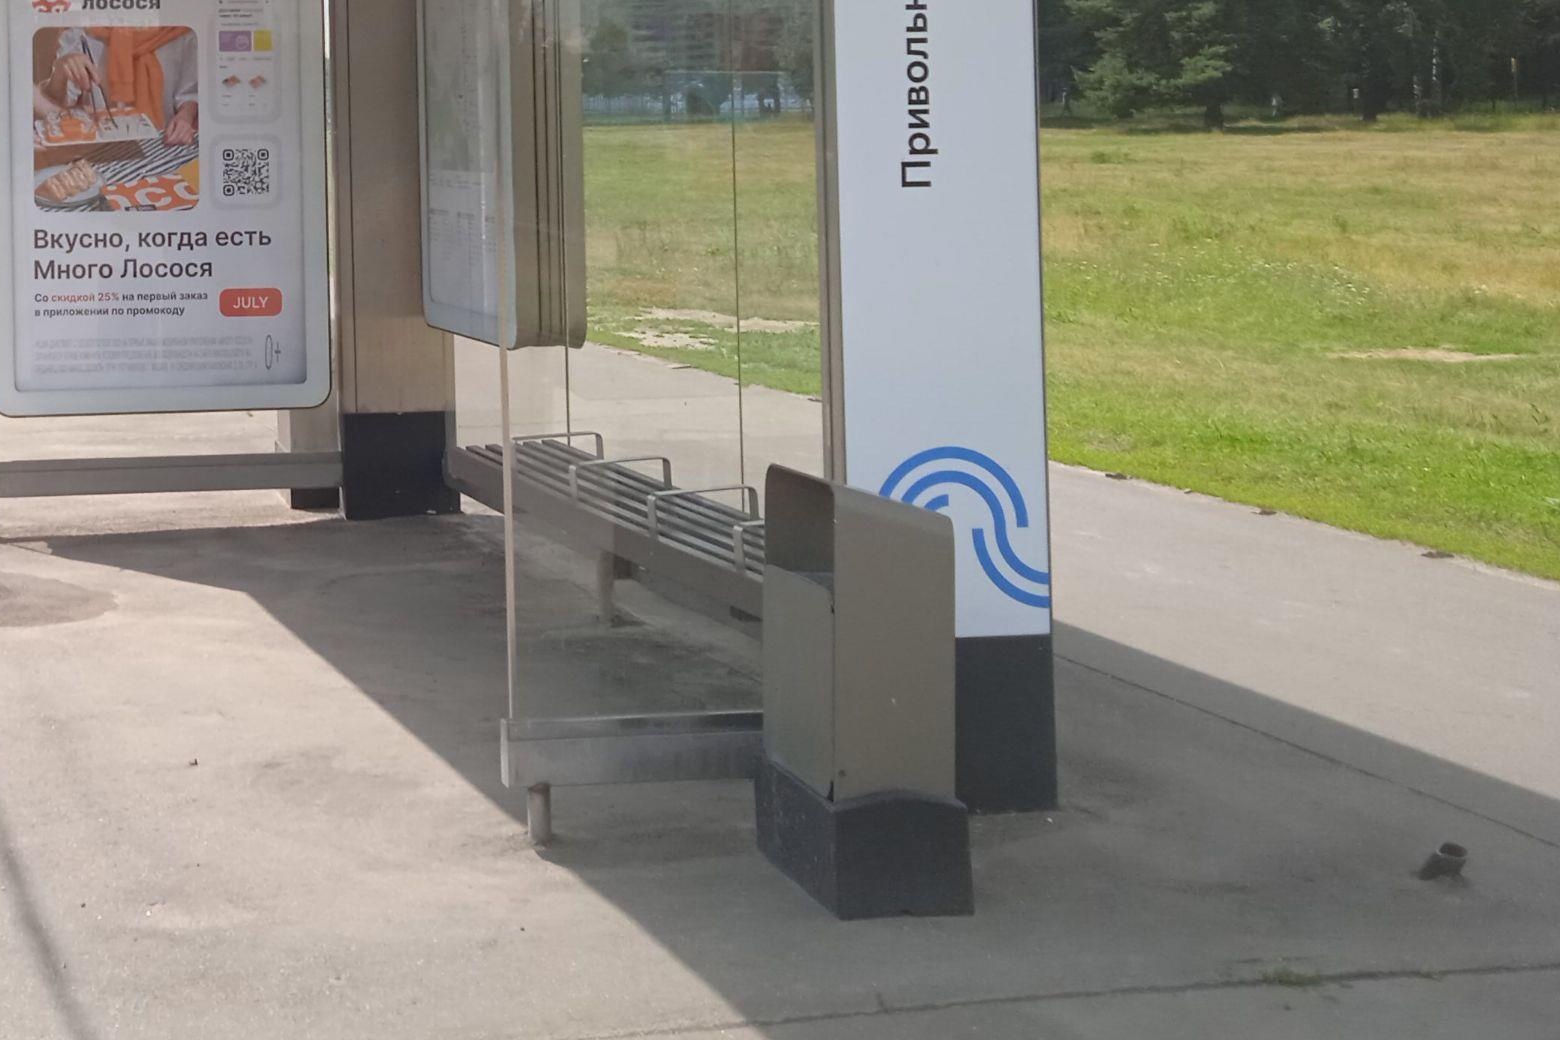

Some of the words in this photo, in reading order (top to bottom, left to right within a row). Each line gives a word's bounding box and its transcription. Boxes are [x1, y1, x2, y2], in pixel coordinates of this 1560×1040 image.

[33, 229, 130, 254] Вкусно,
[138, 230, 208, 251] когда
[215, 230, 272, 247] есть
[33, 260, 113, 280] Много
[120, 258, 213, 279] Лосося
[34, 293, 49, 303] Со
[51, 292, 95, 304] скидкой
[97, 292, 120, 303] 25%
[122, 293, 135, 302] на
[137, 291, 177, 304] первый
[179, 291, 209, 301] заказ
[232, 296, 270, 309] JULY
[34, 308, 41, 317] в
[43, 307, 109, 319] приложении
[111, 307, 125, 316] по
[126, 306, 185, 318] промокоду
